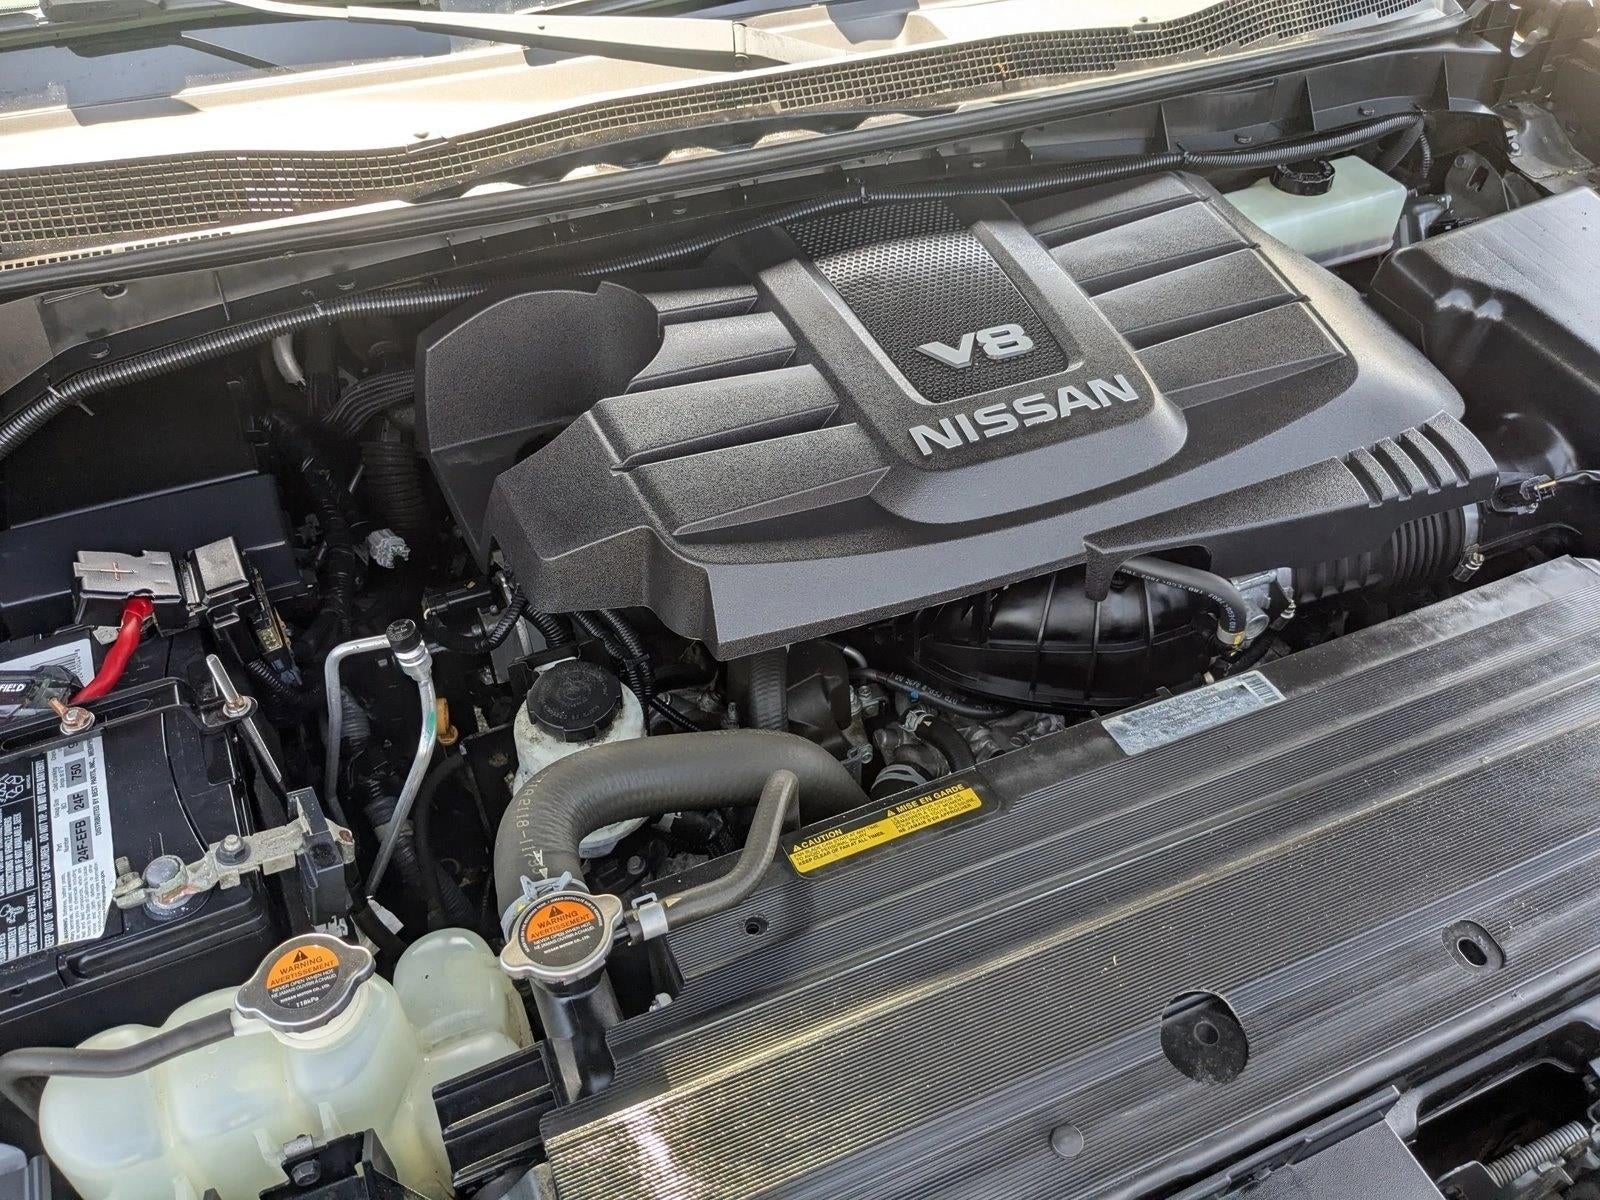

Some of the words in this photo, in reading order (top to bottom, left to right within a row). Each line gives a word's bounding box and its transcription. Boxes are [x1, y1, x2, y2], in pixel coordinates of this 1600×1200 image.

[916, 324, 1034, 369] V8
[909, 374, 1140, 456] NISSAN
[71, 764, 82, 780] 750
[73, 793, 84, 810] 24F
[896, 801, 918, 813] MISE
[920, 795, 932, 805] EN
[933, 784, 964, 799] GARDE
[75, 820, 88, 862] 24F-EFB
[801, 828, 843, 848] CAUTION
[530, 914, 590, 939] AVERTISSEMENT
[537, 910, 578, 928] WARNING
[270, 960, 334, 986] AVERTISSEMENT
[280, 956, 323, 975] WARNING
[296, 996, 319, 1008] 118kPa
